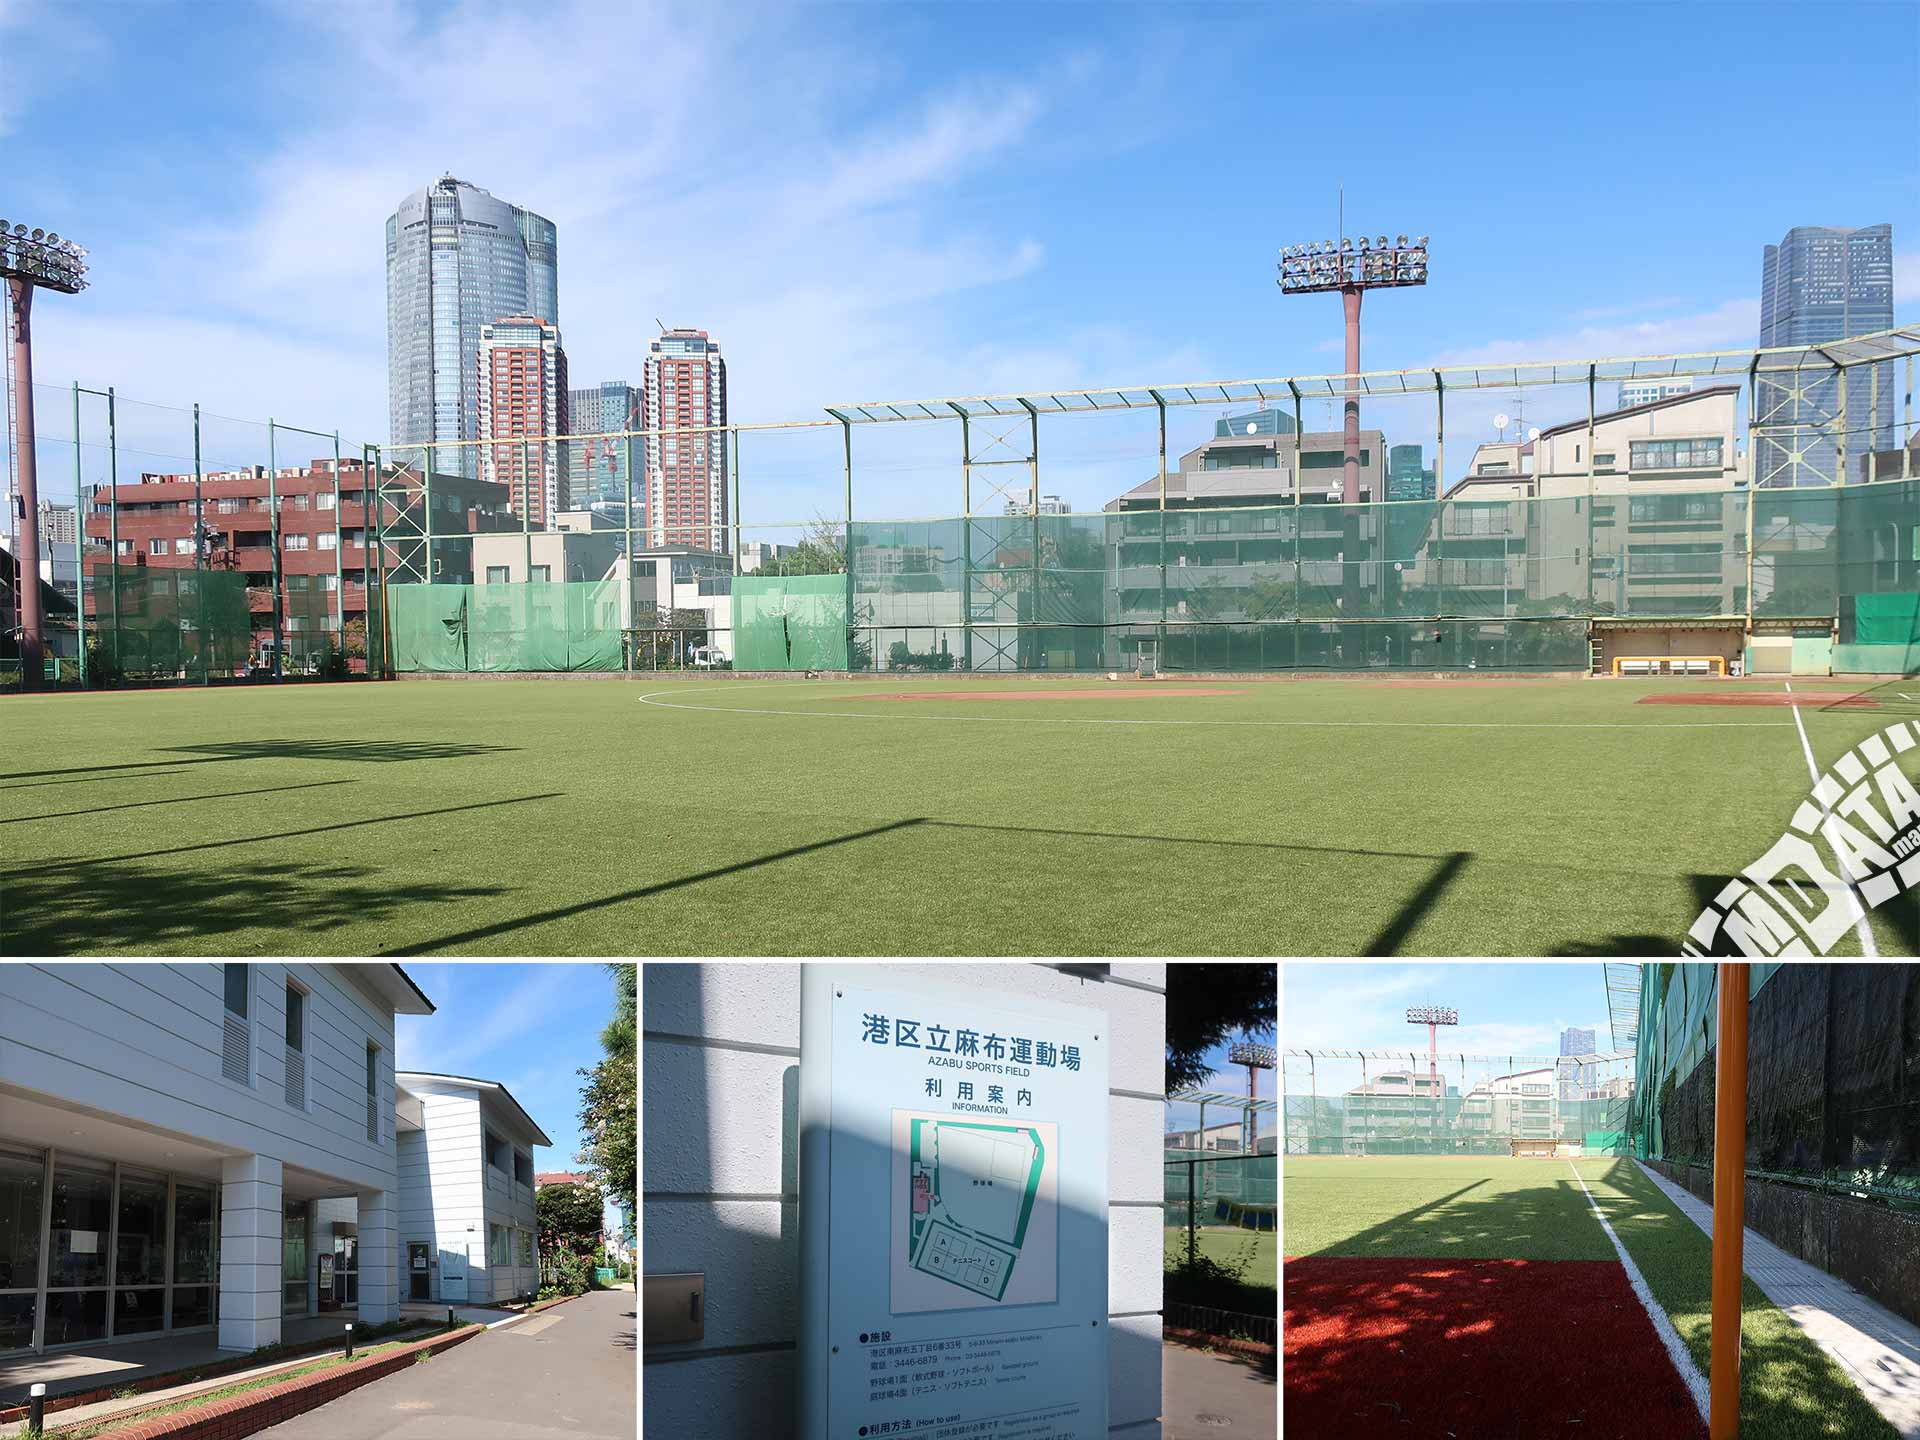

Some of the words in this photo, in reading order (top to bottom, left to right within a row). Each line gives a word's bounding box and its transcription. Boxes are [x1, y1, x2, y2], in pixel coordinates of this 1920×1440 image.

[862, 1013, 1081, 1072] 港区立麻布運動場
[928, 1056, 963, 1069] AZABU
[965, 1061, 1003, 1074] SPORTS
[1005, 1067, 1030, 1078] FIELD
[952, 1102, 1008, 1115] INFORMATION
[940, 1238, 947, 1246] A
[870, 1419, 912, 1435] 利用方法
[936, 1416, 945, 1424] to
